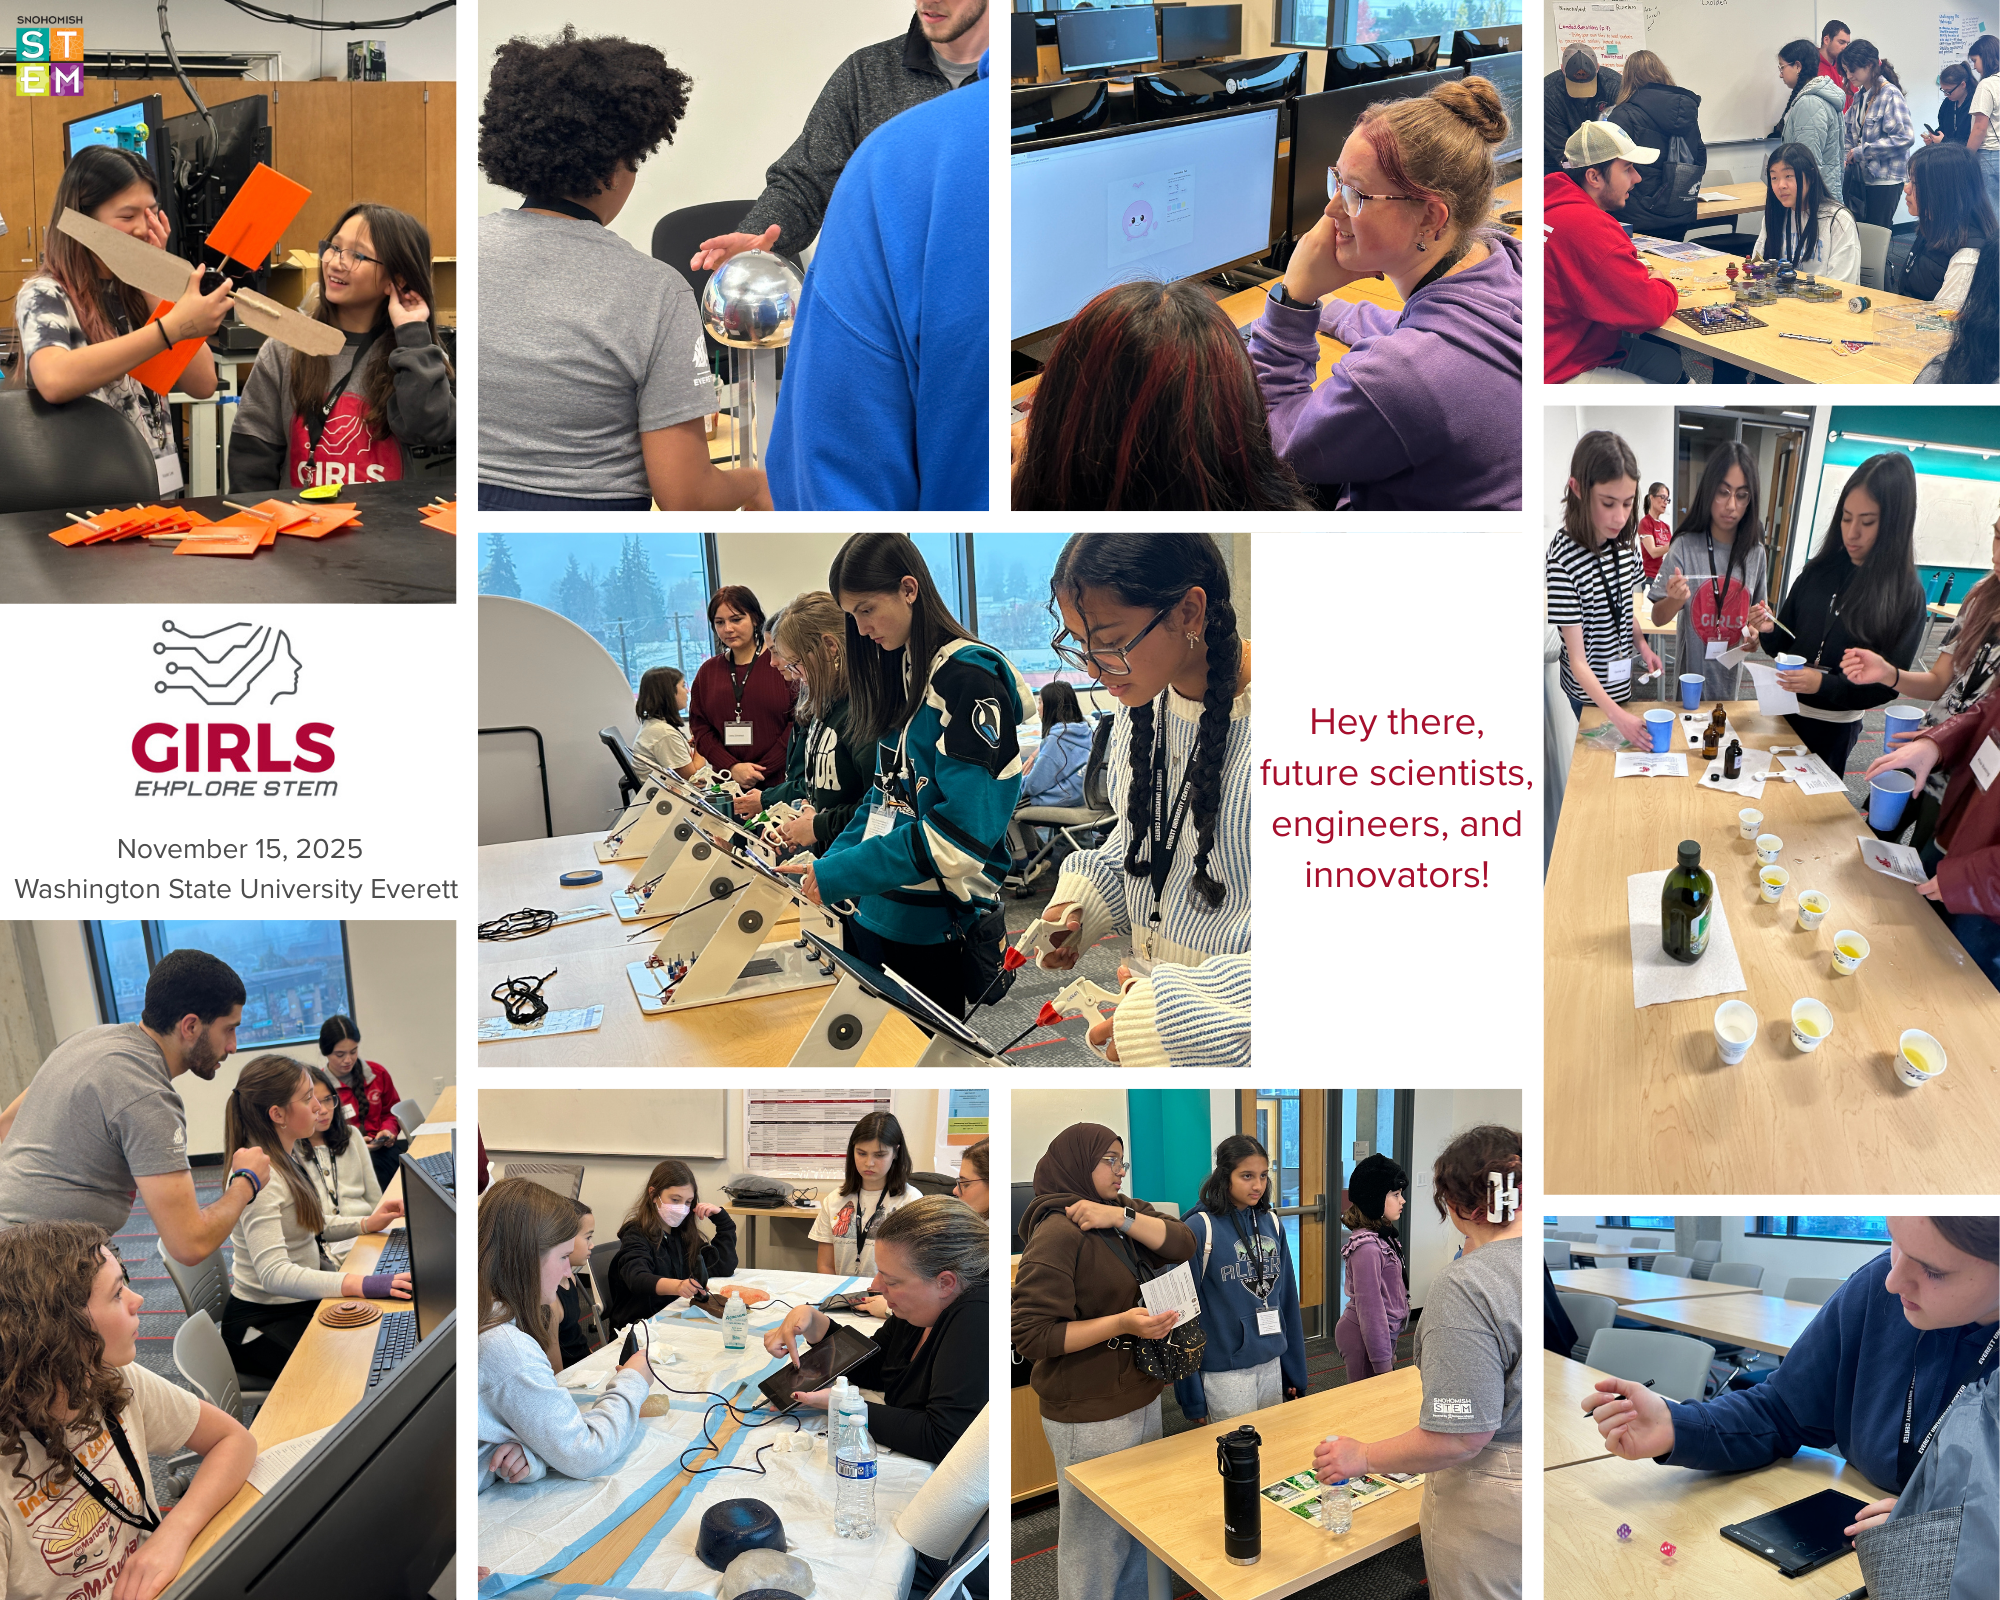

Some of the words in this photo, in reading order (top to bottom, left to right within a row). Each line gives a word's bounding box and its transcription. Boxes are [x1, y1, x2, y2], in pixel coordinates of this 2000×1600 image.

[1700, 613, 1744, 629] GIRLS
[1166, 828, 1176, 850] EVERETT
[1171, 802, 1184, 830] UNIVERSITY
[1181, 781, 1191, 803] CENTER
[1154, 821, 1162, 842] CENTER
[1978, 1338, 1996, 1365] EVERETT
[1434, 1403, 1471, 1413] STEM
[1902, 1422, 1911, 1444] CENTER
[1918, 1432, 1934, 1455] EVERETT
